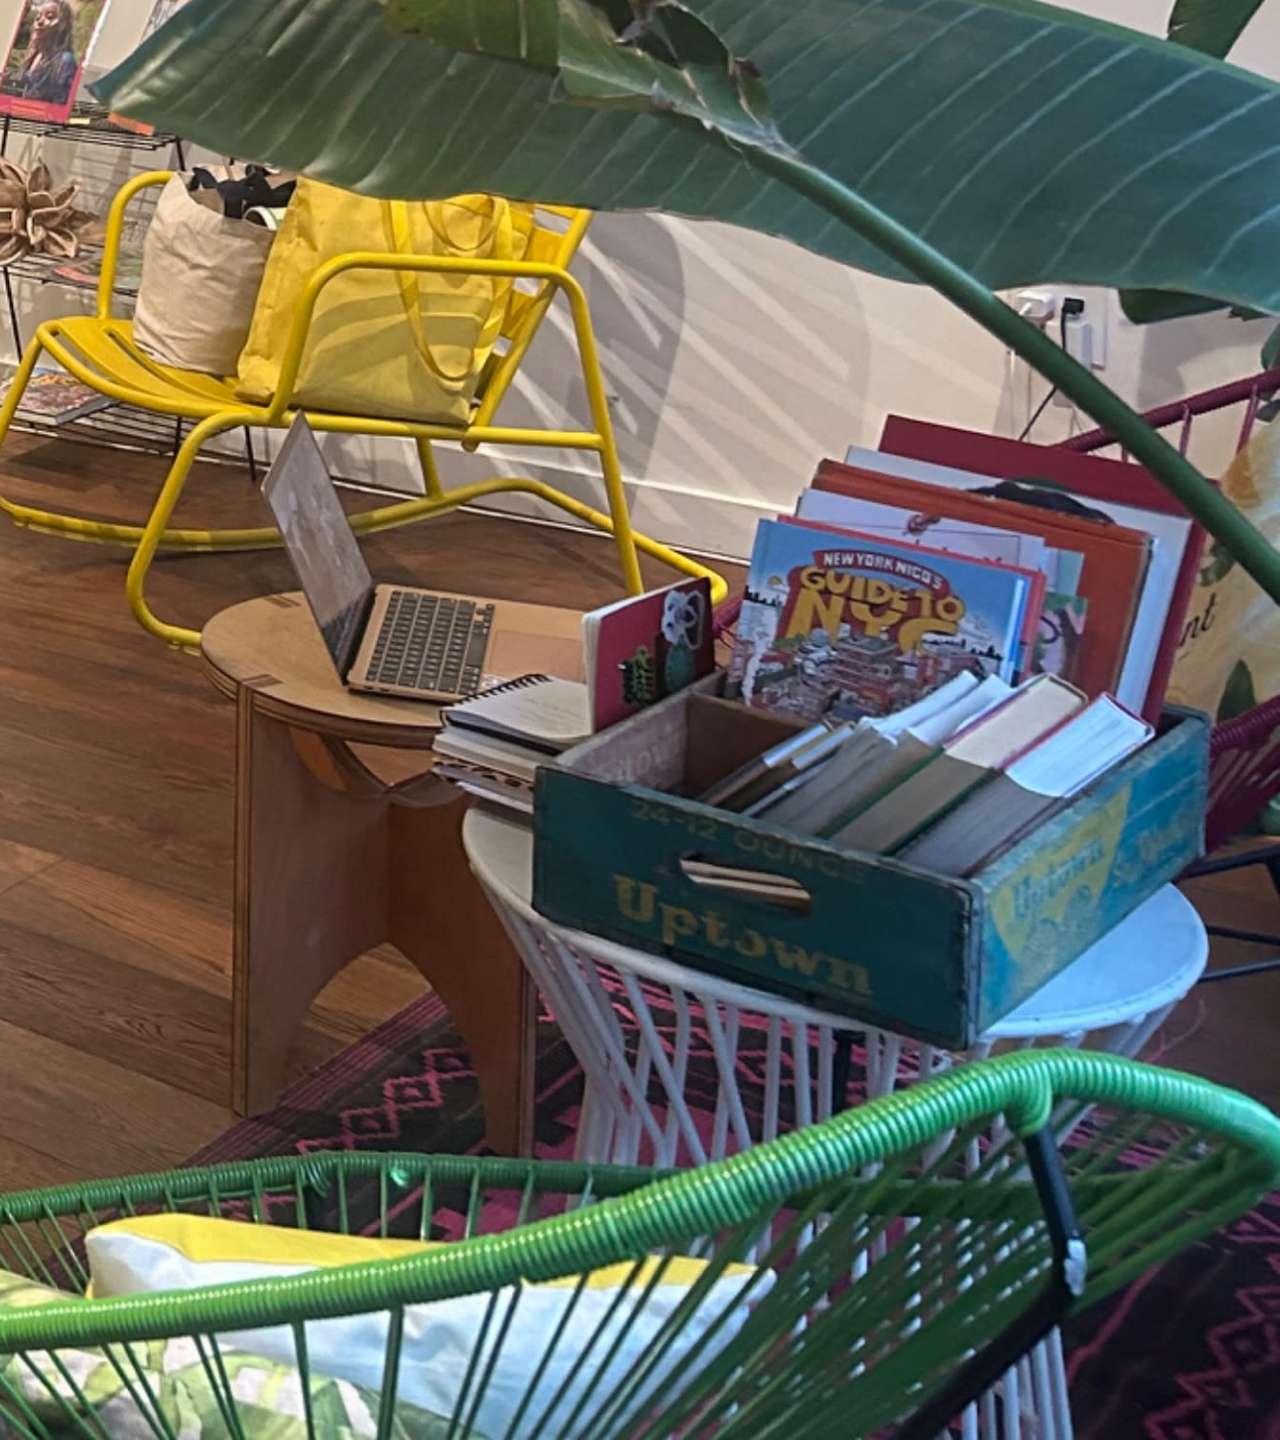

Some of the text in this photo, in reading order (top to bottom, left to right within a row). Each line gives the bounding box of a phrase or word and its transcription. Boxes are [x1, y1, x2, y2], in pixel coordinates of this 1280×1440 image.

[823, 552, 855, 567] NEW
[855, 554, 894, 571] YORK
[786, 587, 959, 654] NYC
[800, 565, 966, 623] GUIDE TO
[613, 871, 874, 994] Uptown
